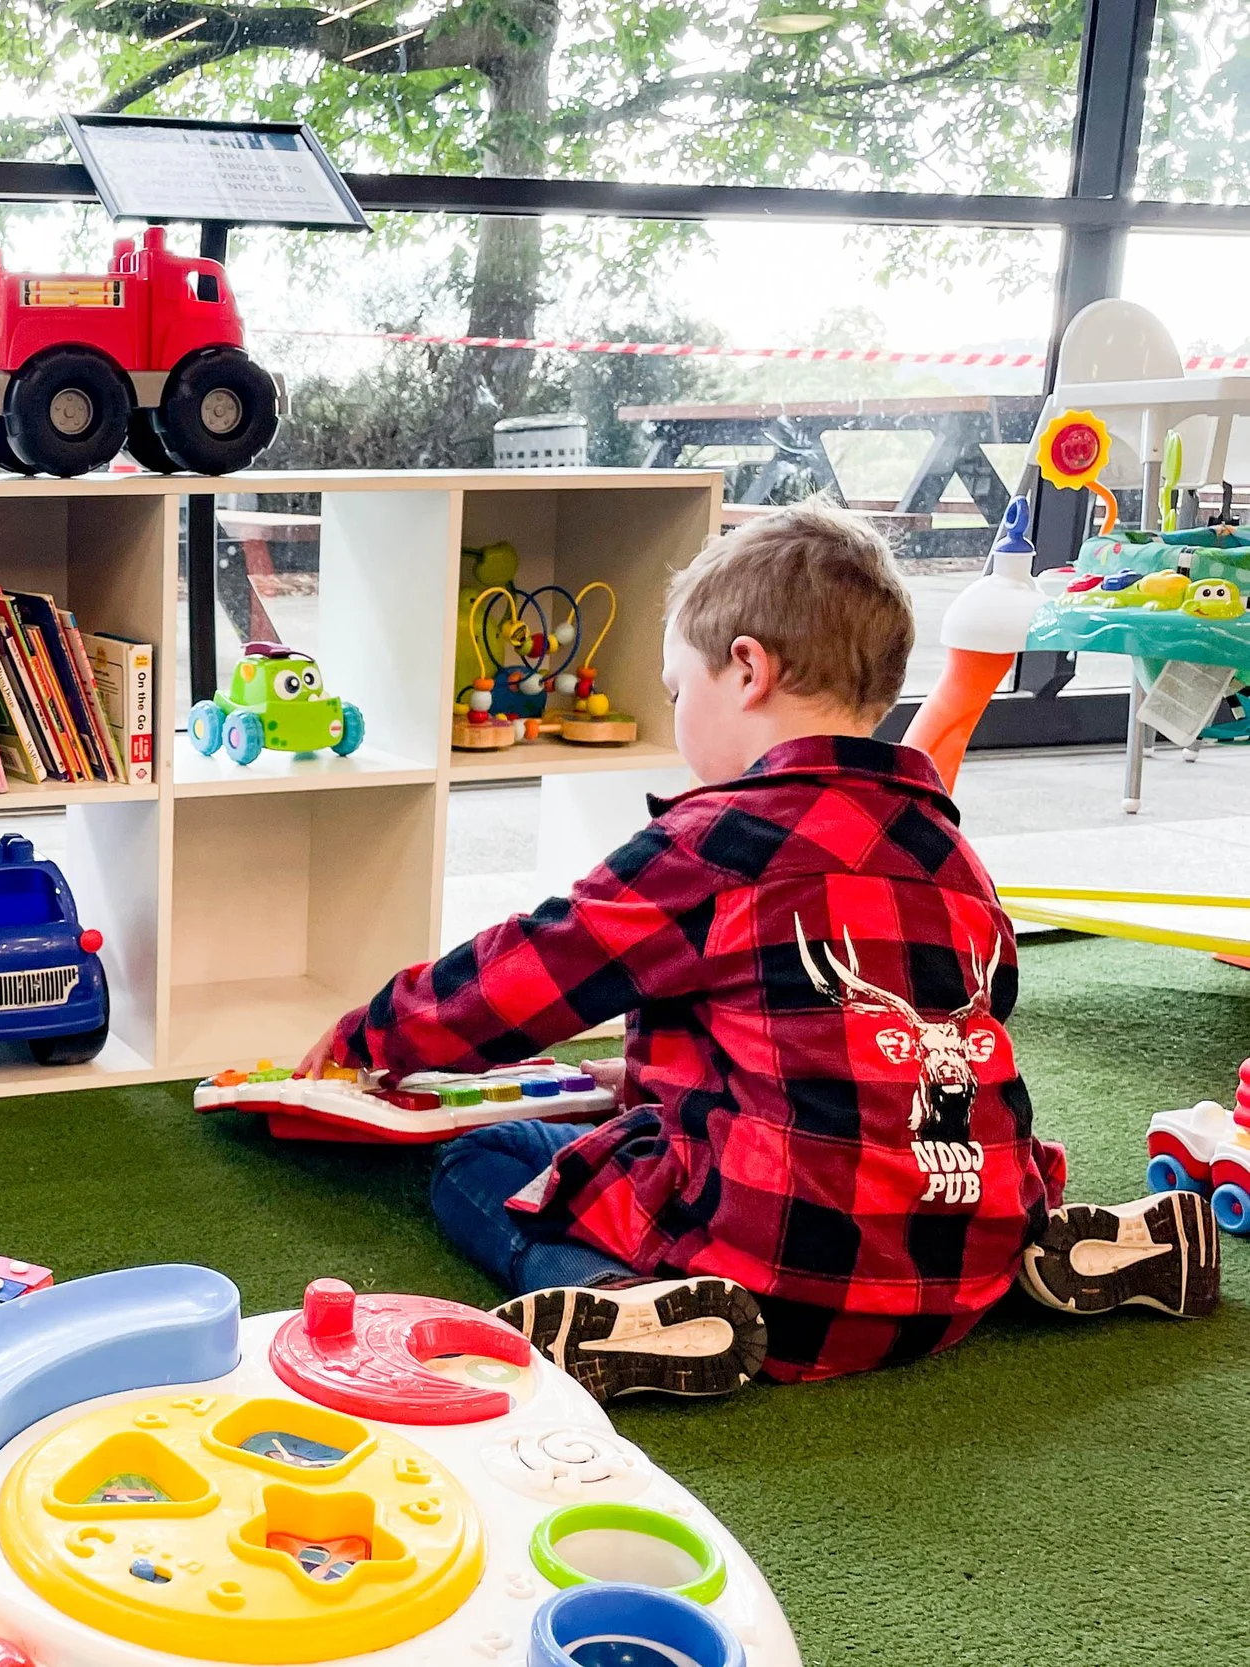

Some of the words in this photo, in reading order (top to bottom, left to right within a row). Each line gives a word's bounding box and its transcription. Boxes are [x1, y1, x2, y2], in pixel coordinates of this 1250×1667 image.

[137, 672, 147, 688] On
[137, 692, 147, 711] the
[137, 714, 147, 731] Go
[910, 1140, 985, 1173] NOOJ
[920, 1171, 981, 1204] PUB
